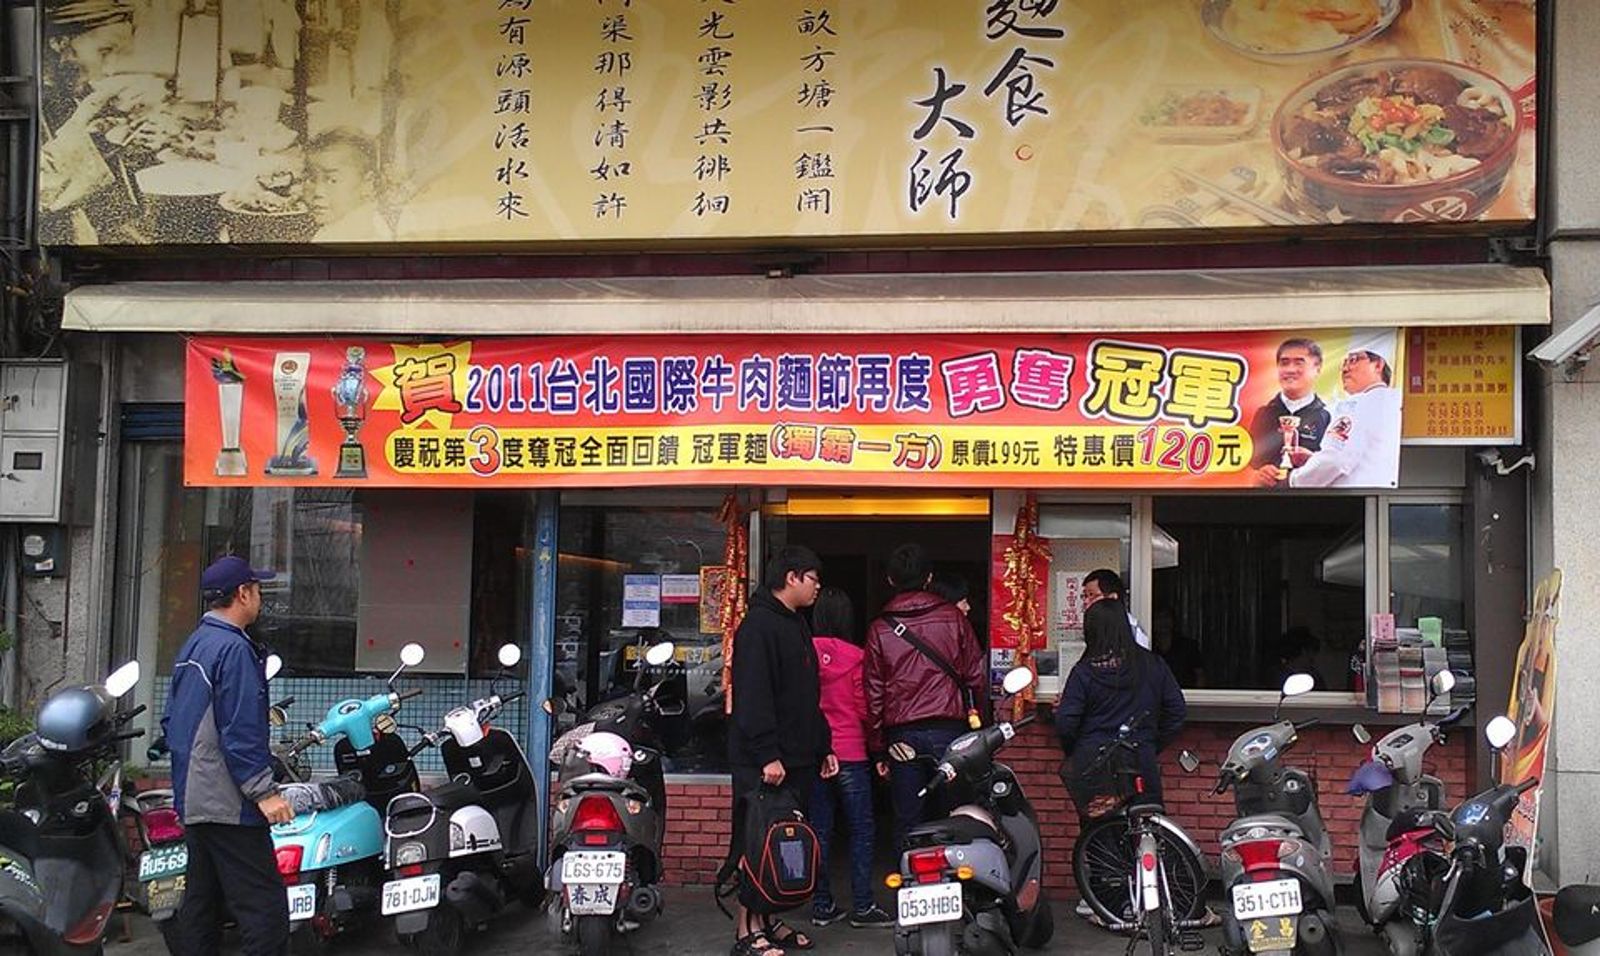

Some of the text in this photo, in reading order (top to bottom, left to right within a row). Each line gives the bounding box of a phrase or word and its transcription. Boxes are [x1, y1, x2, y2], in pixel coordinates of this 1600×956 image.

[590, 0, 633, 219] 渠那得清如許
[691, 0, 735, 217] 光雲影共徘徊
[910, 67, 975, 219] 大師
[395, 354, 462, 424] 賀
[1236, 890, 1300, 914] 351-CTH
